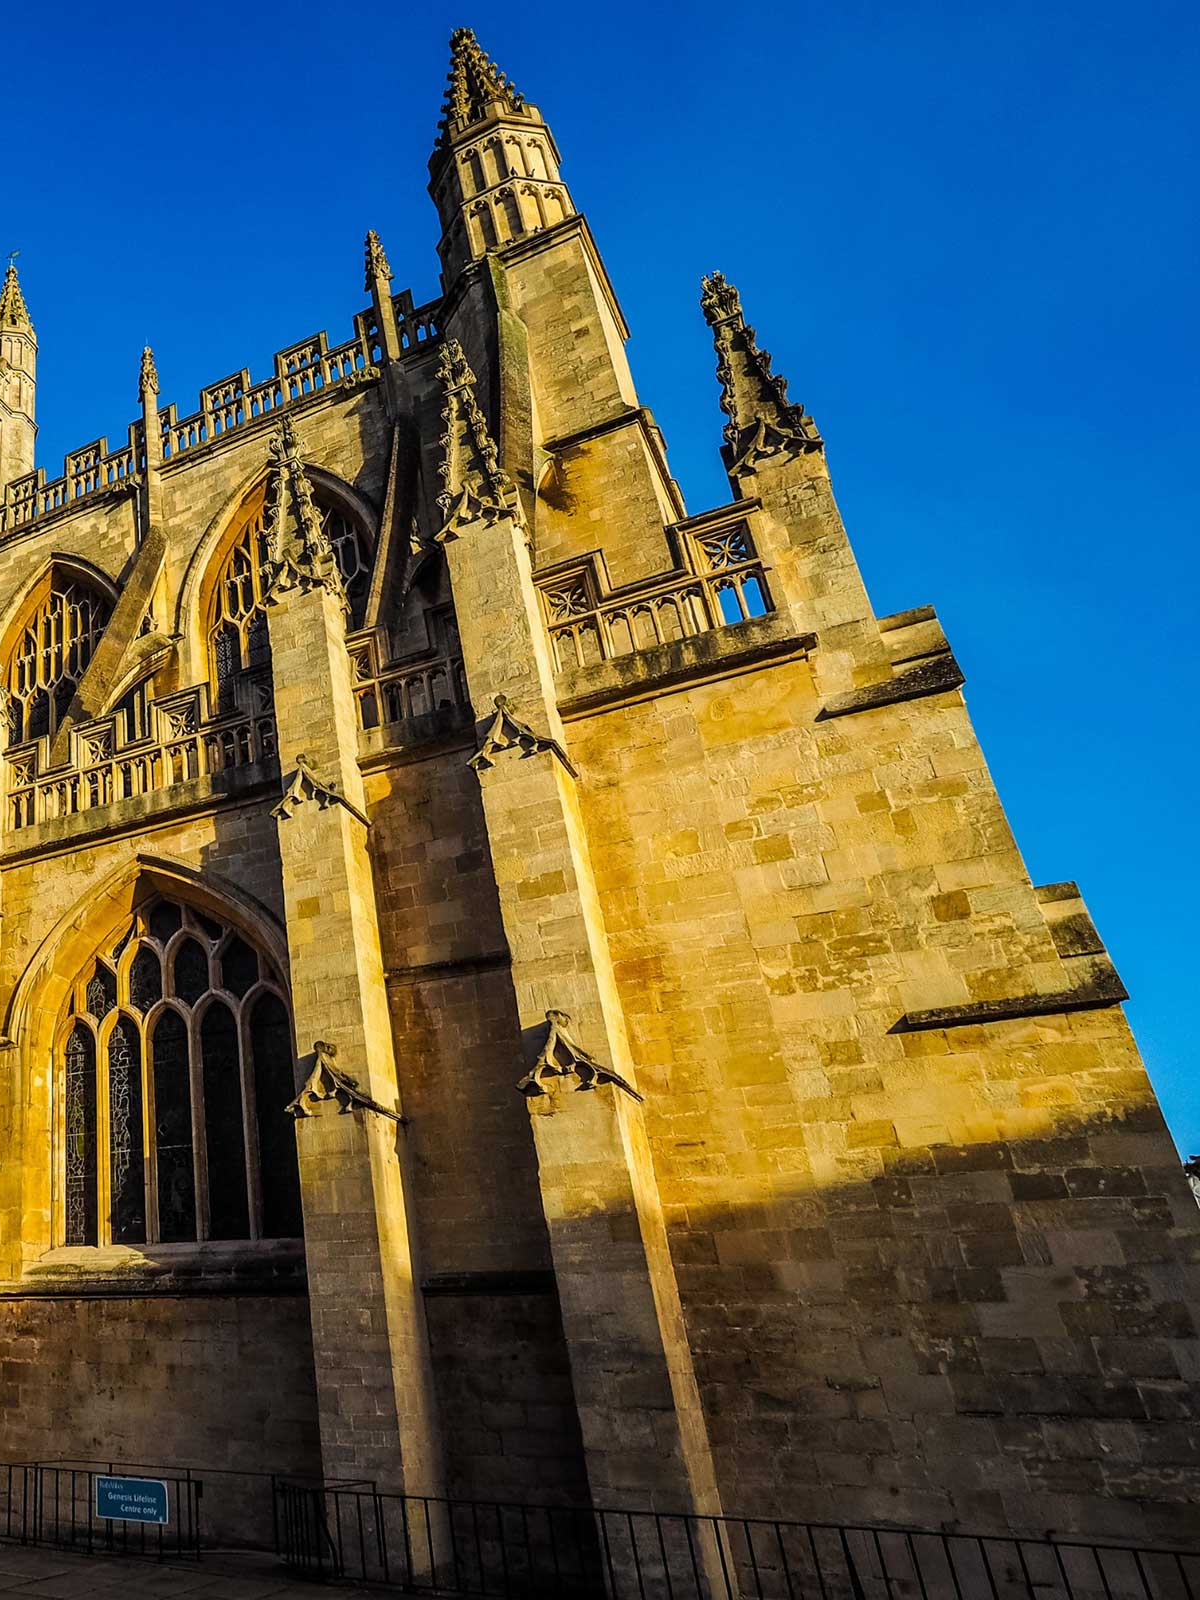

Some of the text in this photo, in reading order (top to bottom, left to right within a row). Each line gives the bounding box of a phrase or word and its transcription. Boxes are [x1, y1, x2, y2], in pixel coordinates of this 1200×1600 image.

[107, 1491, 157, 1504] Genesis Lifeline
[120, 1503, 157, 1516] Centre only
